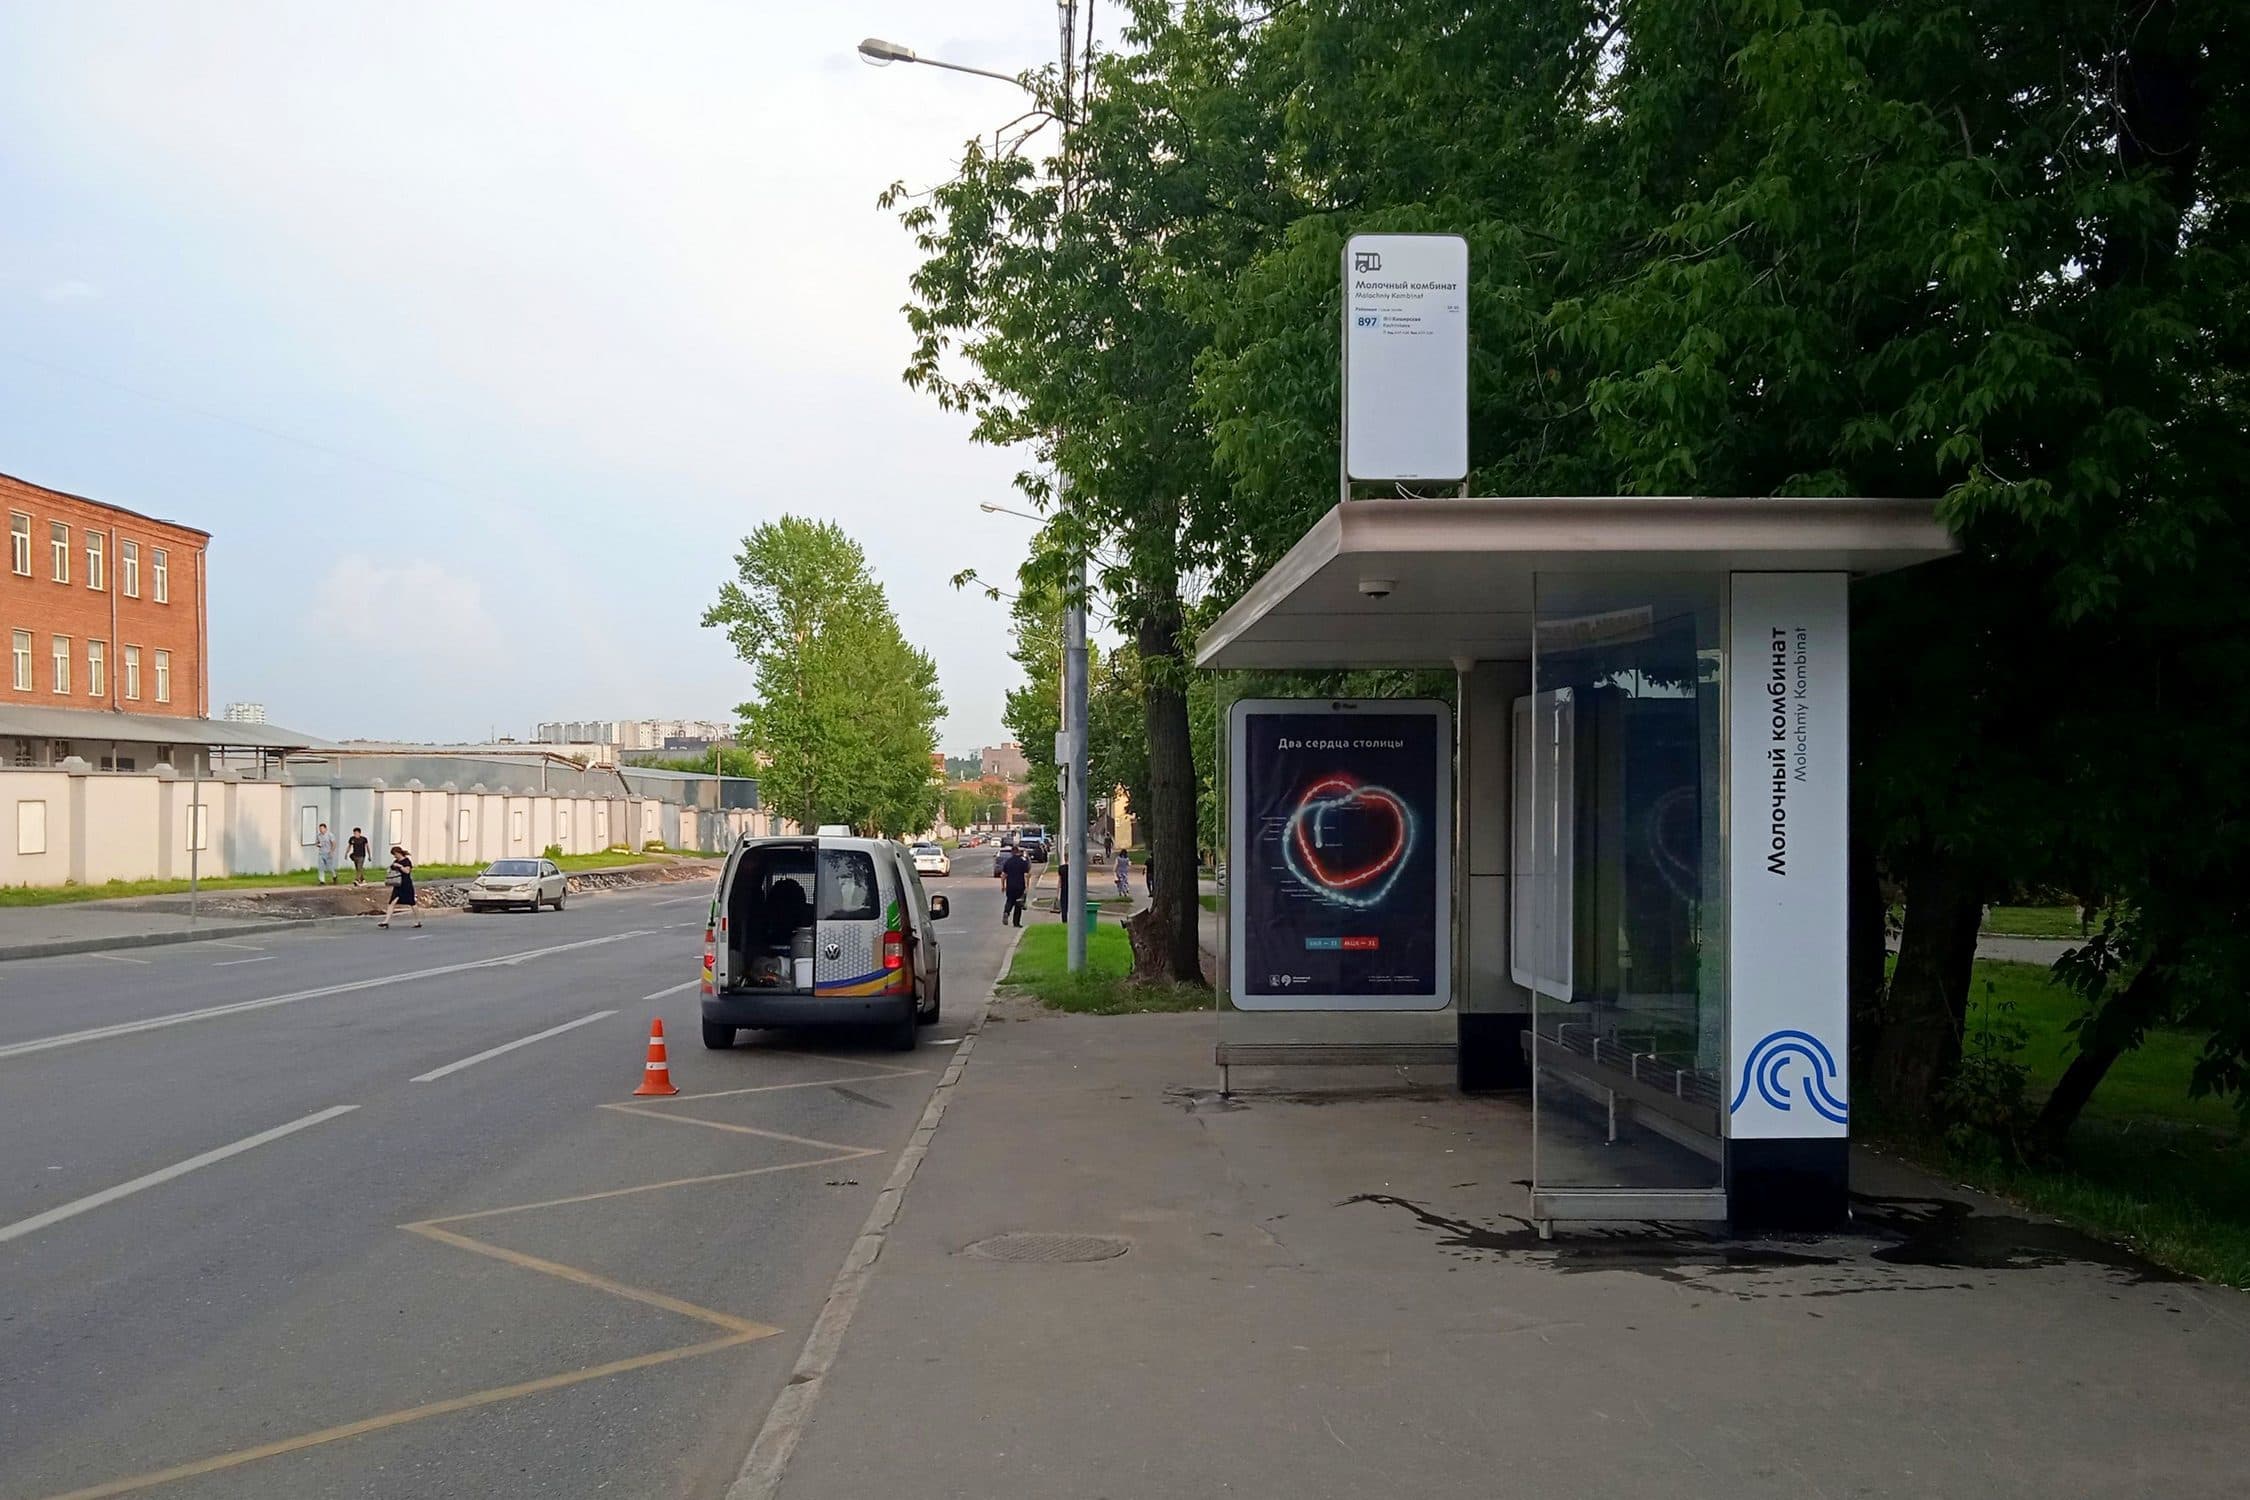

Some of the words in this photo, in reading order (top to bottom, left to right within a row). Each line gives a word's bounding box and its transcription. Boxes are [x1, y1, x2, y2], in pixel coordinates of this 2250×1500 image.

[1355, 280, 1408, 290] Молочный
[1410, 281, 1457, 291] комбинат
[1358, 317, 1377, 327] 897
[1767, 627, 1786, 741] комбинат
[1793, 627, 1807, 699] Kombinat
[1278, 738, 1302, 750] Два
[1305, 739, 1349, 750] сердца
[1352, 739, 1404, 749] столицы
[1794, 703, 1809, 782] Molochniy
[1767, 750, 1786, 876] Молочный
